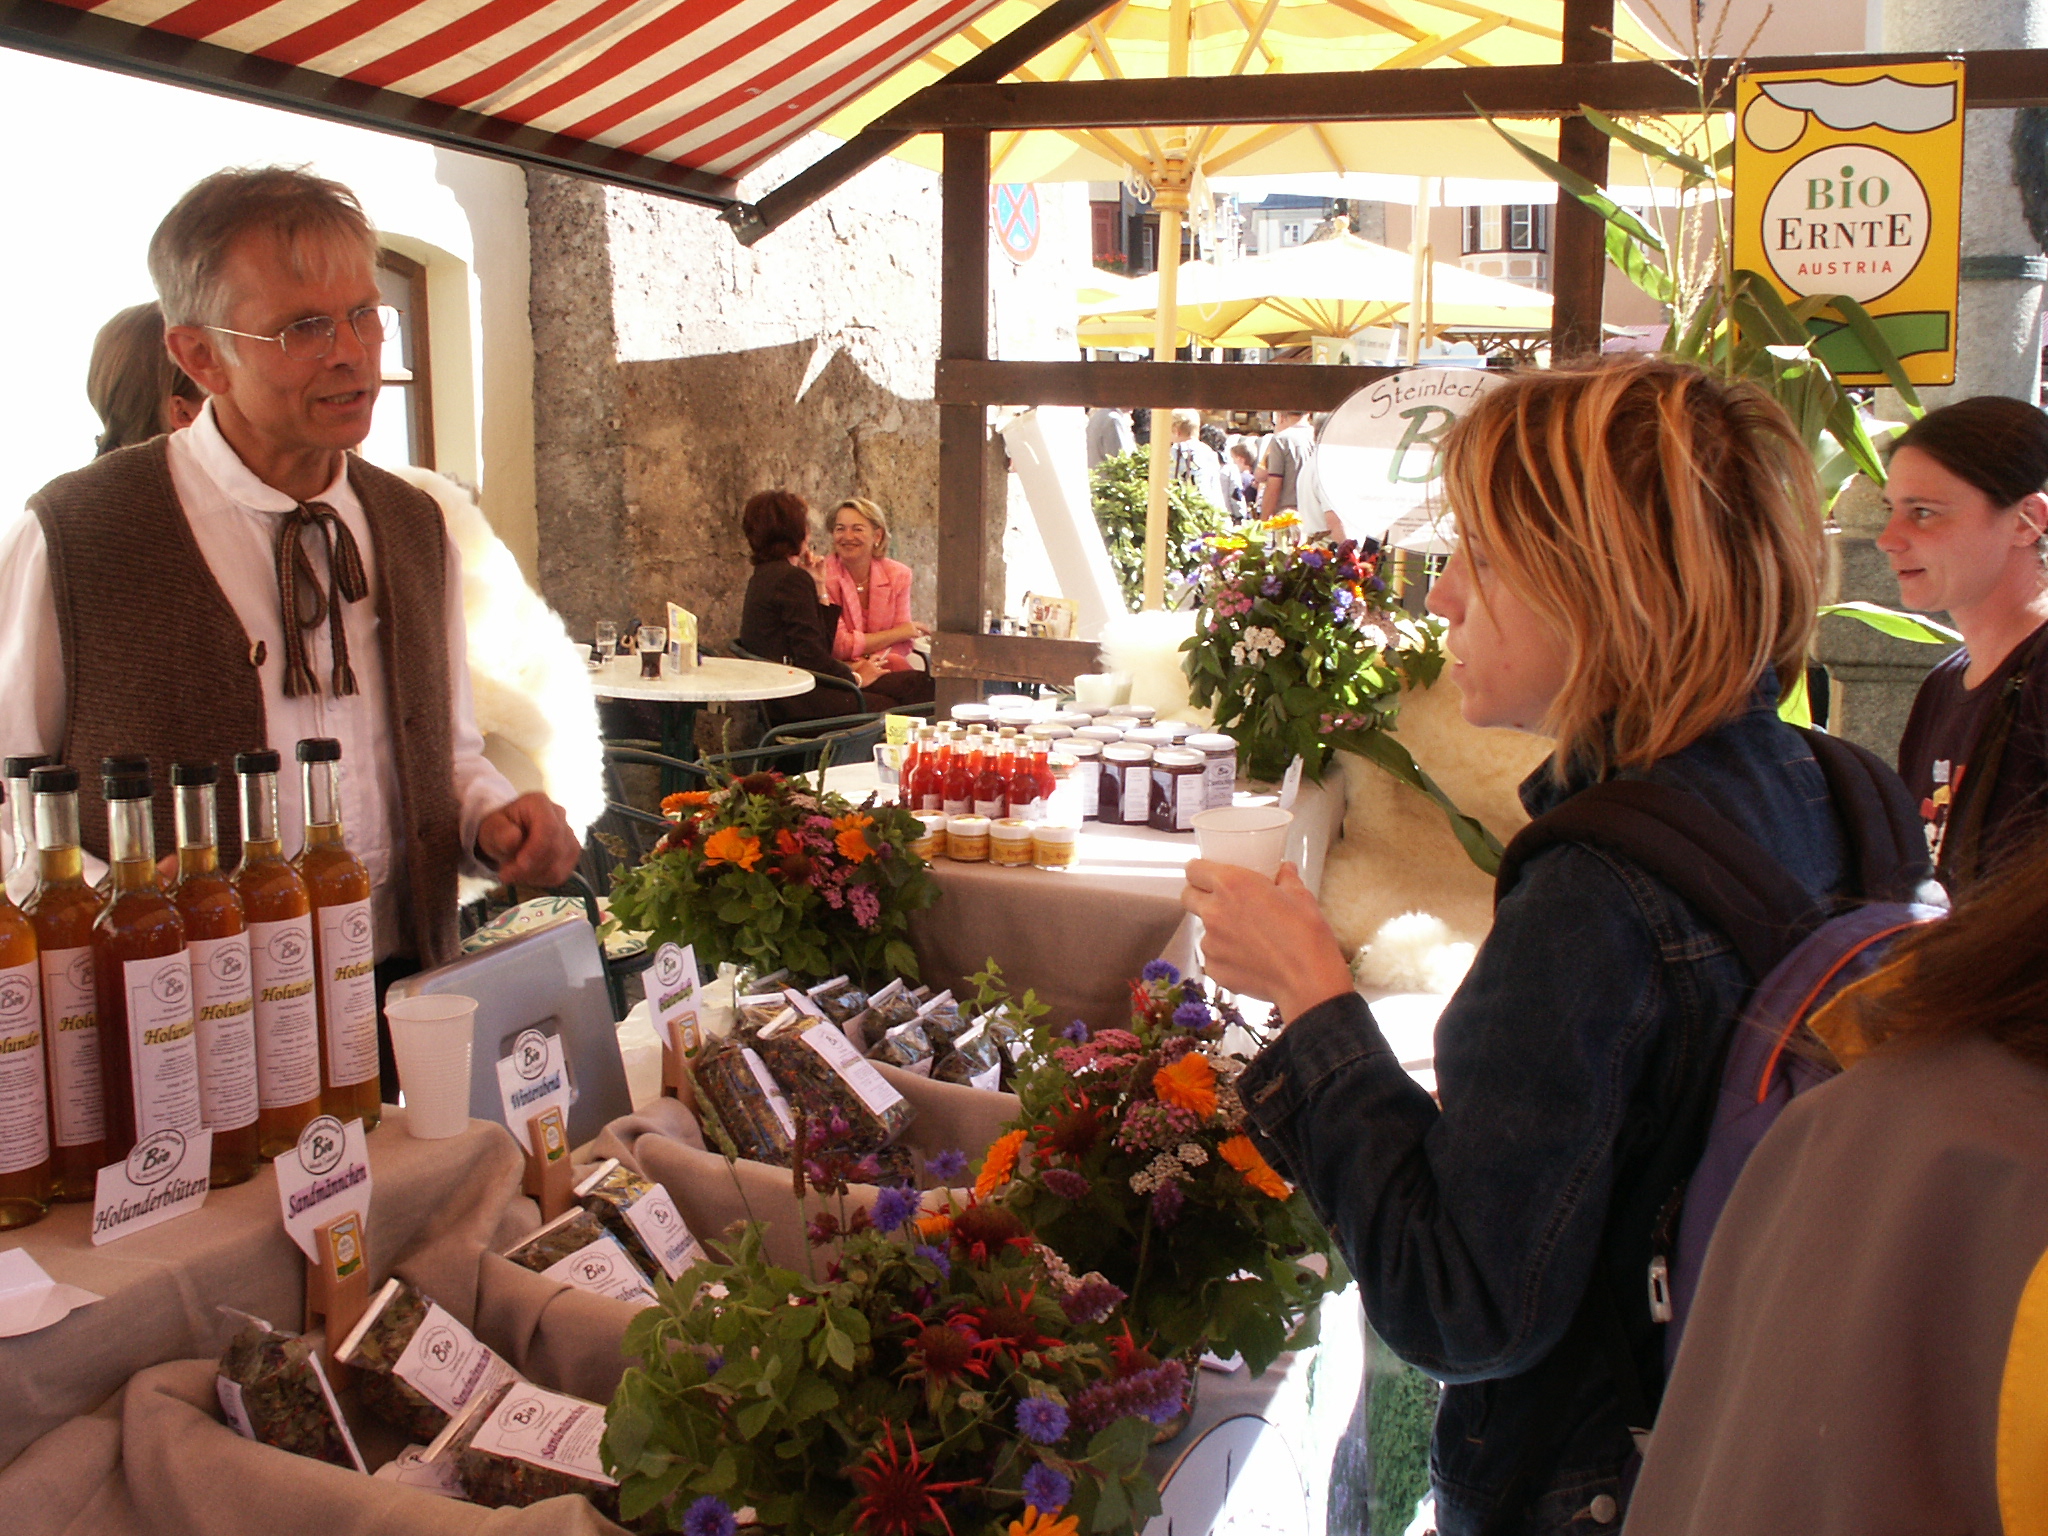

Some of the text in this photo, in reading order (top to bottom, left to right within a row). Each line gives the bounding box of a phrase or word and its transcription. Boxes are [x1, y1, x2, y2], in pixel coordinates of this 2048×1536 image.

[1776, 213, 1912, 251] ERNTE
[1797, 260, 1893, 276] AUSTRIA
[1371, 372, 1486, 419] Steinlech
[1387, 405, 1456, 484] B
[281, 941, 301, 959] Bio
[222, 956, 242, 976] Bio
[165, 976, 183, 997] Bio
[1, 989, 25, 1010] Bio
[524, 1046, 541, 1067] Bio
[313, 1135, 334, 1160] Bio
[142, 1147, 171, 1171] Bio
[288, 1163, 367, 1219] Sandmännchen
[93, 1176, 208, 1235] Holunderblüten
[582, 1263, 606, 1281] Bio
[431, 1339, 453, 1363] Bio
[513, 1406, 538, 1425] Bio
